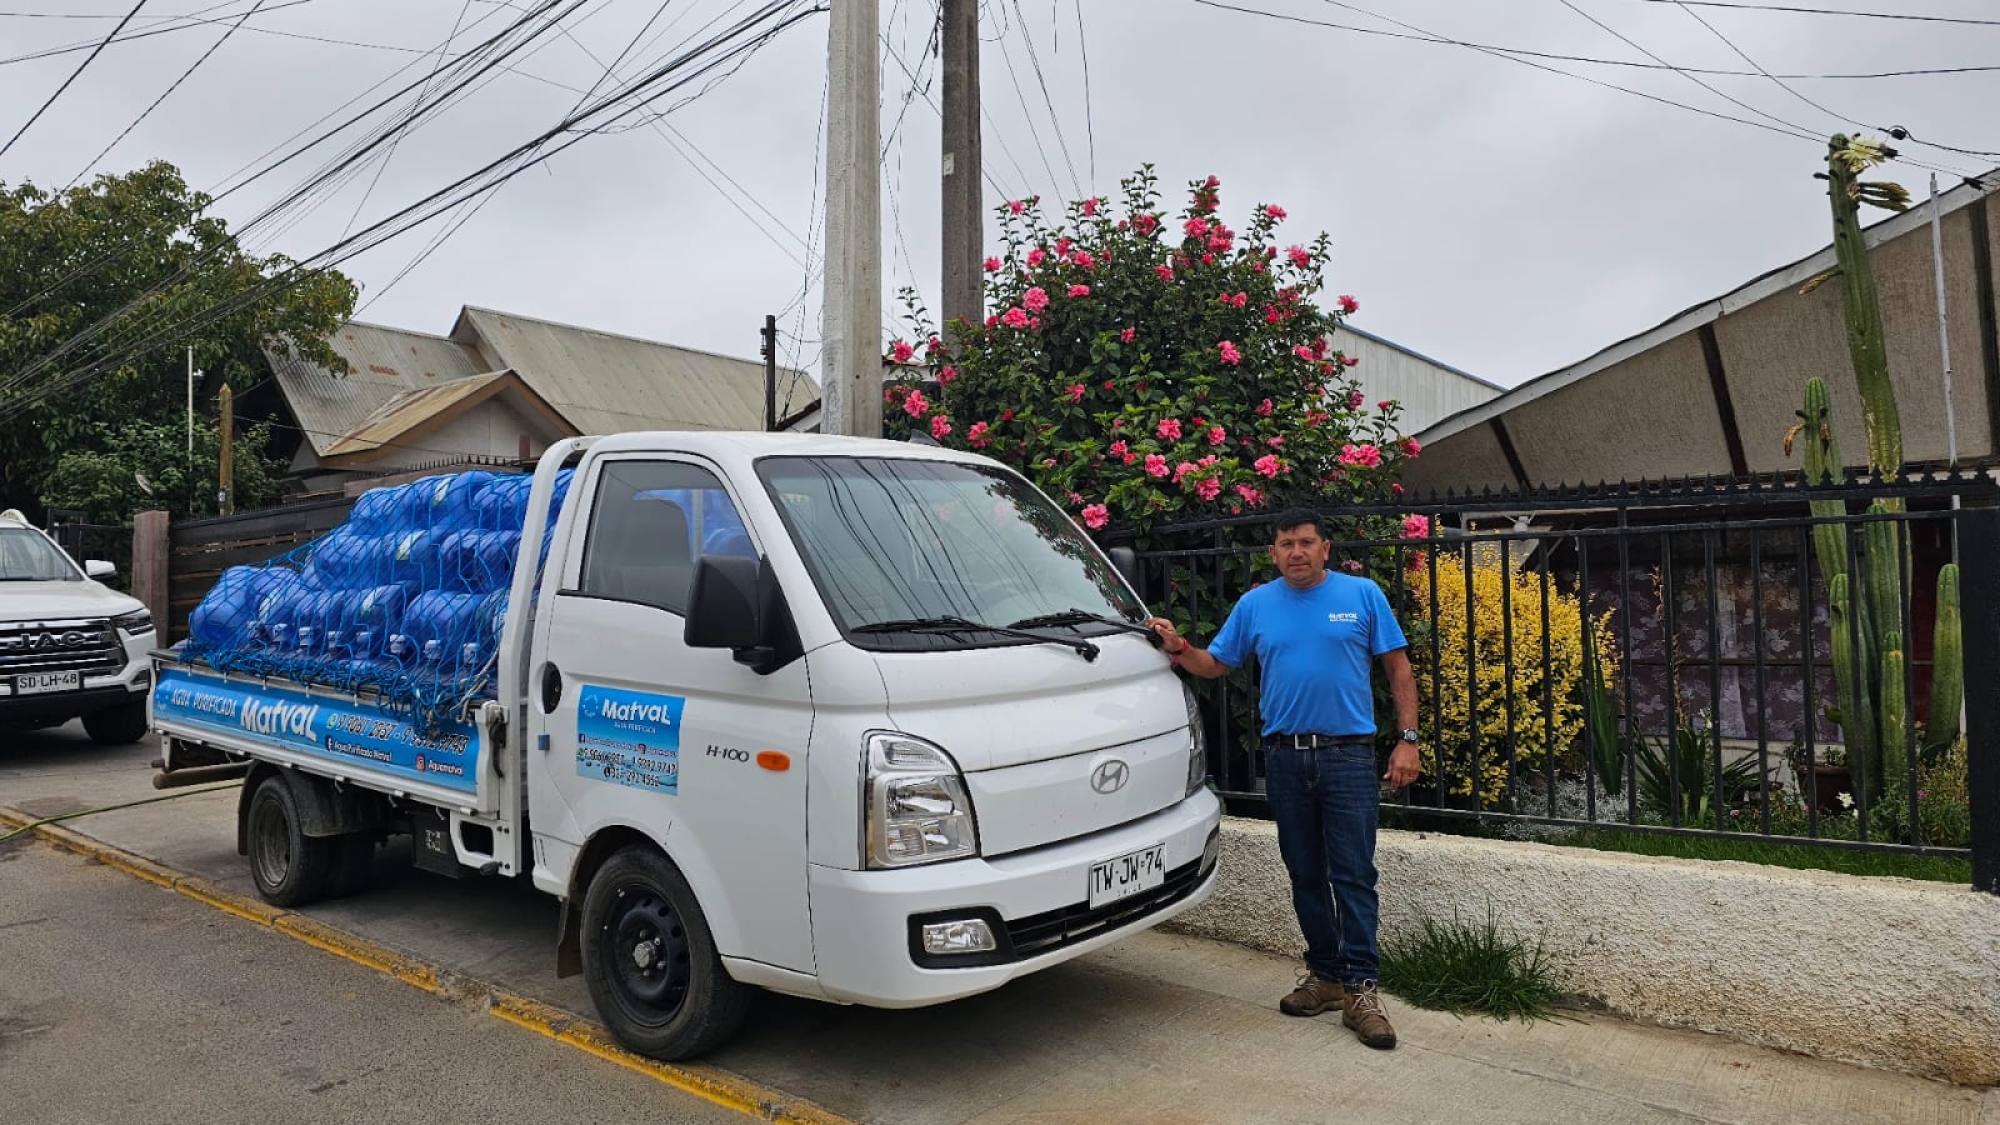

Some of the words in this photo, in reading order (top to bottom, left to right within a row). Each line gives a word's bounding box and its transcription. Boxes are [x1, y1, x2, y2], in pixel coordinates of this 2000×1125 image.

[7, 630, 86, 651] JAC
[172, 687, 191, 706] AGUA
[193, 692, 238, 718] PURIFICADA
[706, 744, 750, 762] H-100
